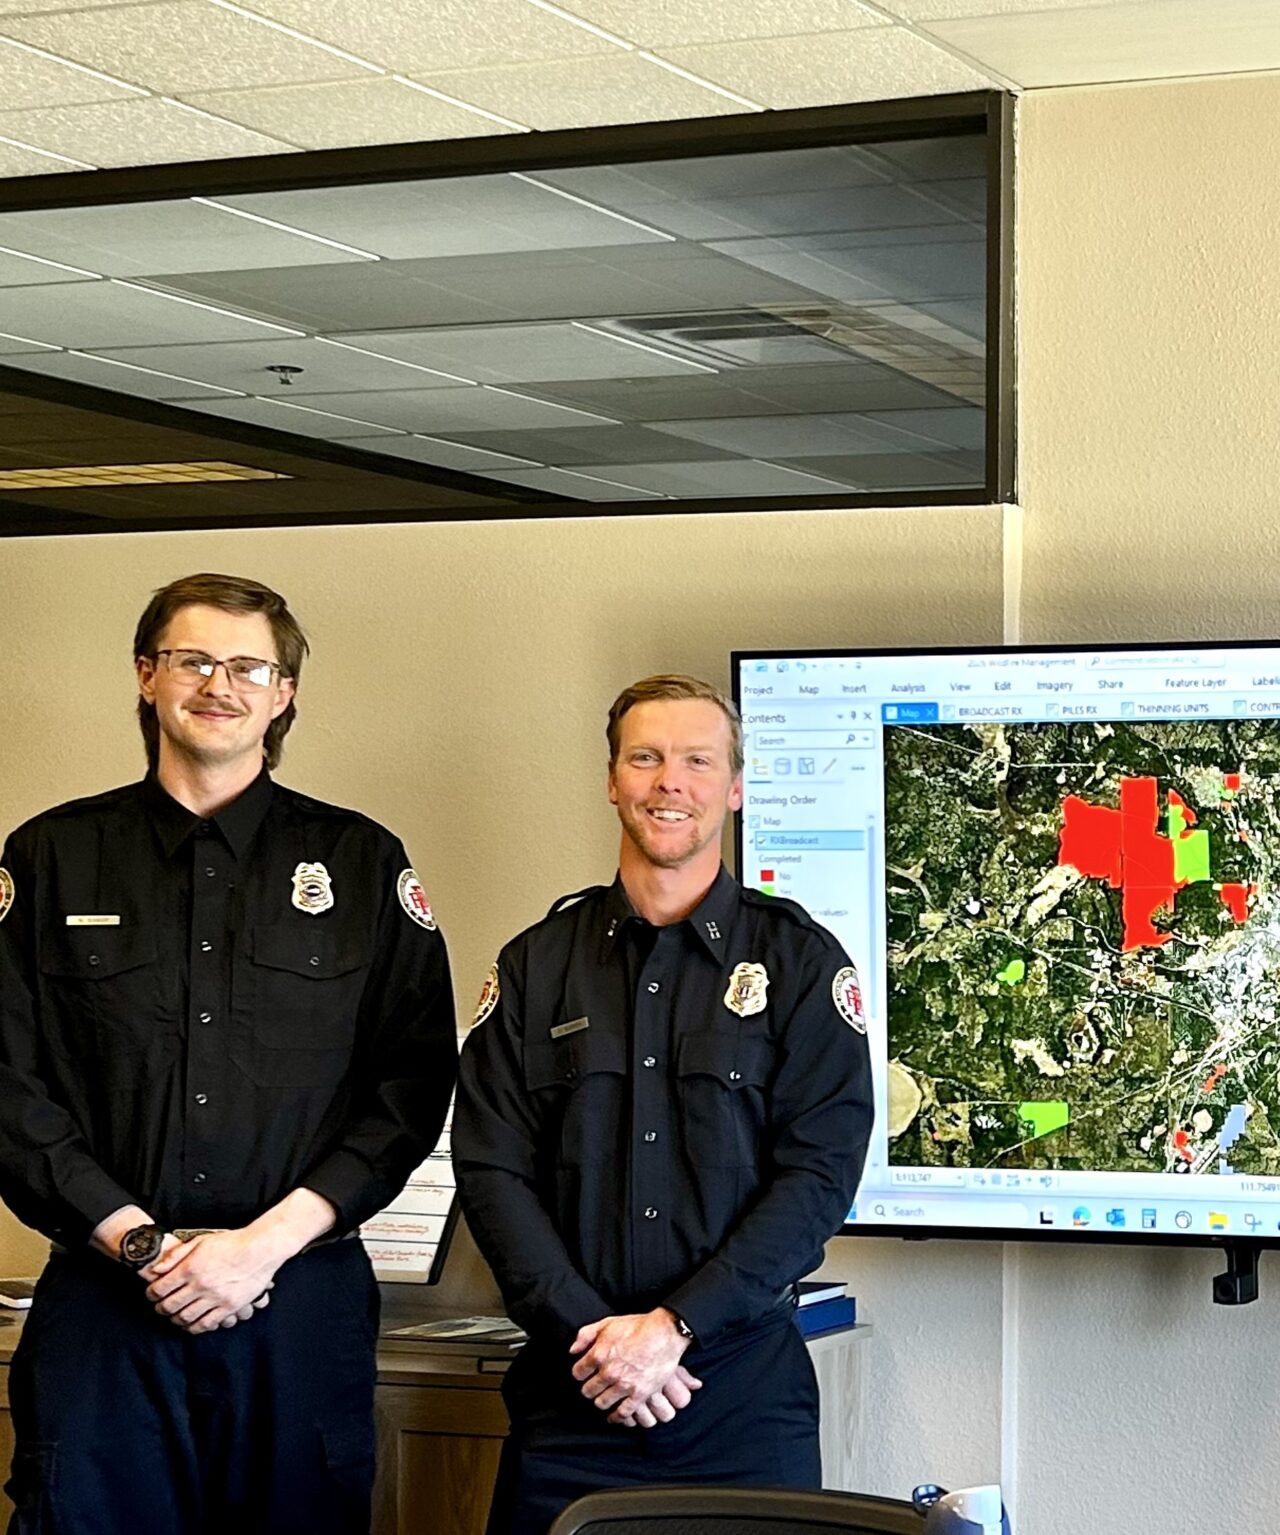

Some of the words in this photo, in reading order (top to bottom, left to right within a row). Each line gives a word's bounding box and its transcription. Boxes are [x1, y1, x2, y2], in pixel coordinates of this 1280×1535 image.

[842, 684, 867, 693] Insert
[949, 682, 971, 692] View
[994, 681, 1012, 691] Edit
[1036, 681, 1074, 692] Imagery
[1098, 679, 1124, 689] Share
[1165, 678, 1199, 688] Feature
[1202, 678, 1227, 689] Layer
[743, 686, 774, 696] Project
[799, 686, 819, 696] Map
[891, 683, 926, 695] Analysis
[959, 707, 1010, 716] BROADCAST
[1011, 706, 1023, 716] RX
[1062, 706, 1084, 715] PILES
[1086, 705, 1098, 715] RX
[1137, 704, 1182, 713] THINNING
[1184, 703, 1210, 713] UNITS
[741, 713, 786, 724] Contents
[758, 736, 785, 746] Search
[748, 795, 788, 808] Drawing
[789, 795, 818, 805] Order
[763, 817, 781, 827] Map
[758, 854, 802, 865] Completed
[779, 872, 791, 881] No
[893, 1206, 925, 1217] Search
